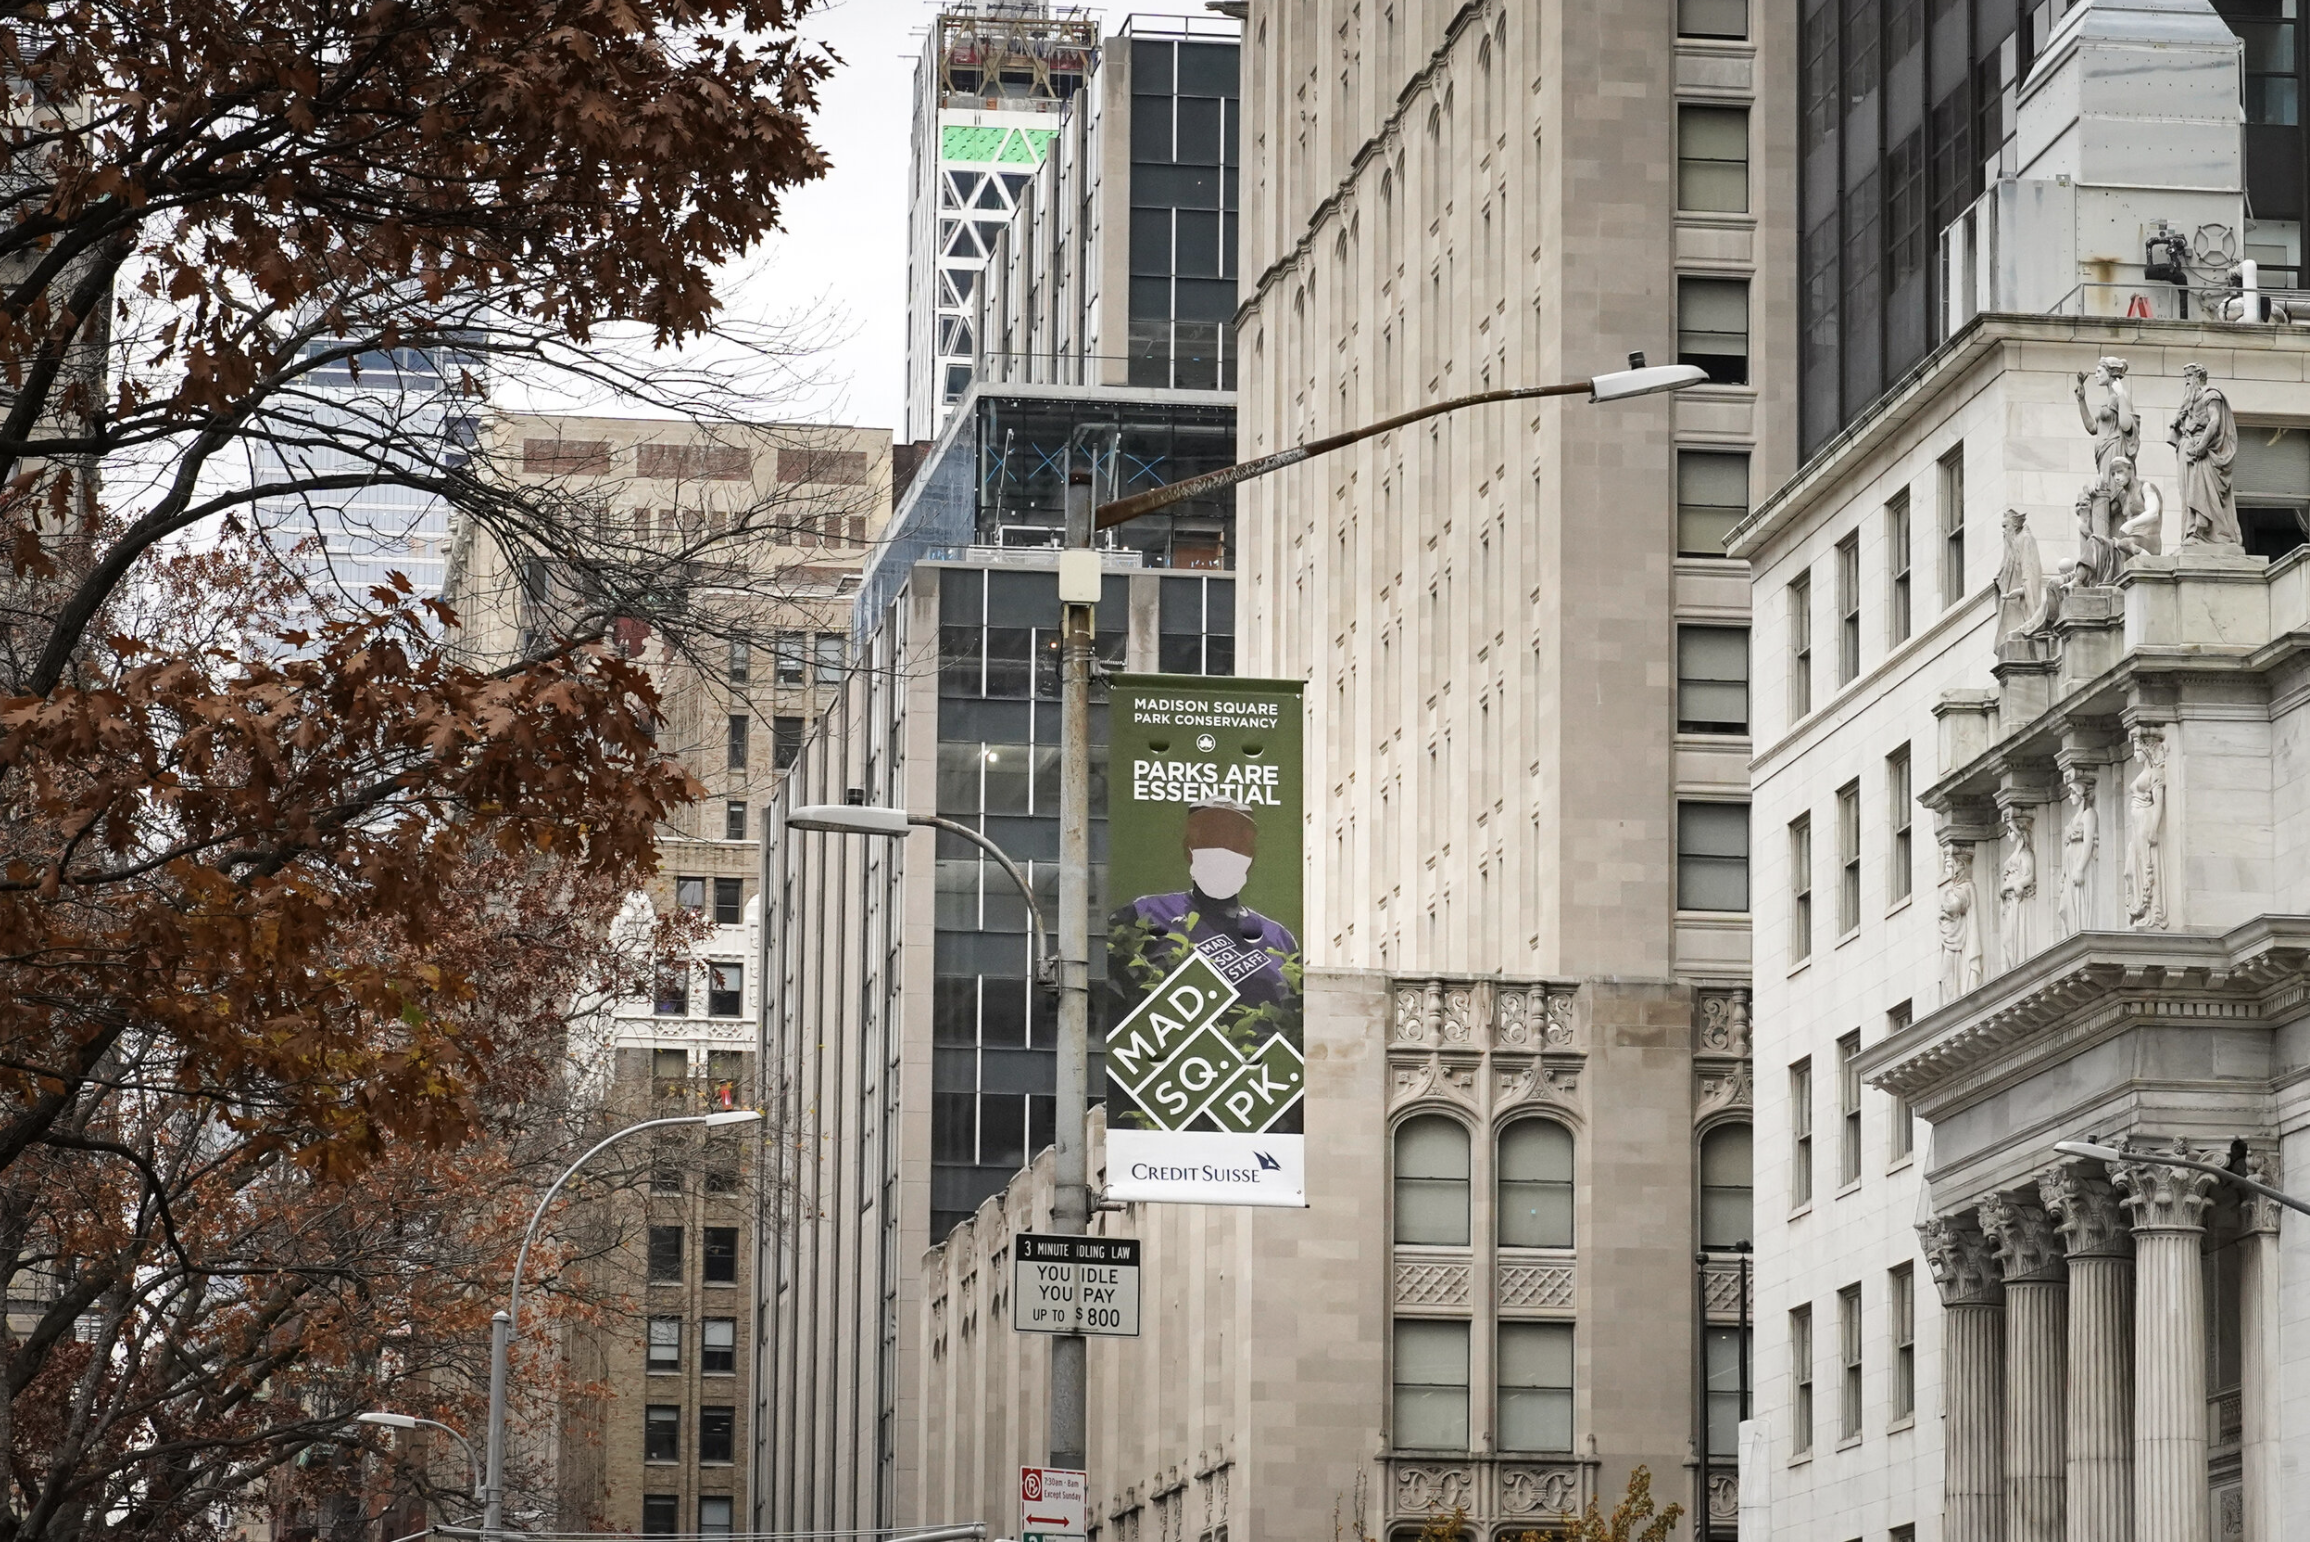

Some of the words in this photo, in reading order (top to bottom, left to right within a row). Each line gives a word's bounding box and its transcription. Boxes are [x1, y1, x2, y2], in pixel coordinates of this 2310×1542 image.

[1134, 698, 1209, 713] MADISON
[1213, 701, 1279, 715] SQUARE
[1134, 713, 1171, 724] PARK
[1174, 714, 1278, 728] CONSERVANCY
[1134, 760, 1219, 783] PARKS
[1224, 764, 1279, 785] ARE
[1134, 780, 1281, 805] ESSENTIAL
[1200, 938, 1231, 954] MAD.
[1112, 984, 1218, 1075] MAD.
[1155, 1056, 1230, 1116] SQ.
[1225, 1064, 1299, 1127] PK.
[1131, 1162, 1199, 1182] CREDIT
[1202, 1164, 1261, 1183] SUISSE
[1024, 1240, 1032, 1257] 3
[1037, 1242, 1070, 1257] MINUTE
[1076, 1244, 1105, 1259] IDLING
[1111, 1246, 1131, 1260] LAW
[1037, 1265, 1071, 1282] YOU
[1081, 1267, 1119, 1284] IDLE
[1039, 1285, 1073, 1302] YOU
[1083, 1287, 1116, 1304] PAY
[1033, 1308, 1048, 1321] UP
[1052, 1309, 1065, 1322] TO
[1044, 1477, 1063, 1487] 7:30am
[1067, 1479, 1079, 1488] 8am
[1044, 1490, 1062, 1500] Except
[1063, 1491, 1081, 1502] Sunday
